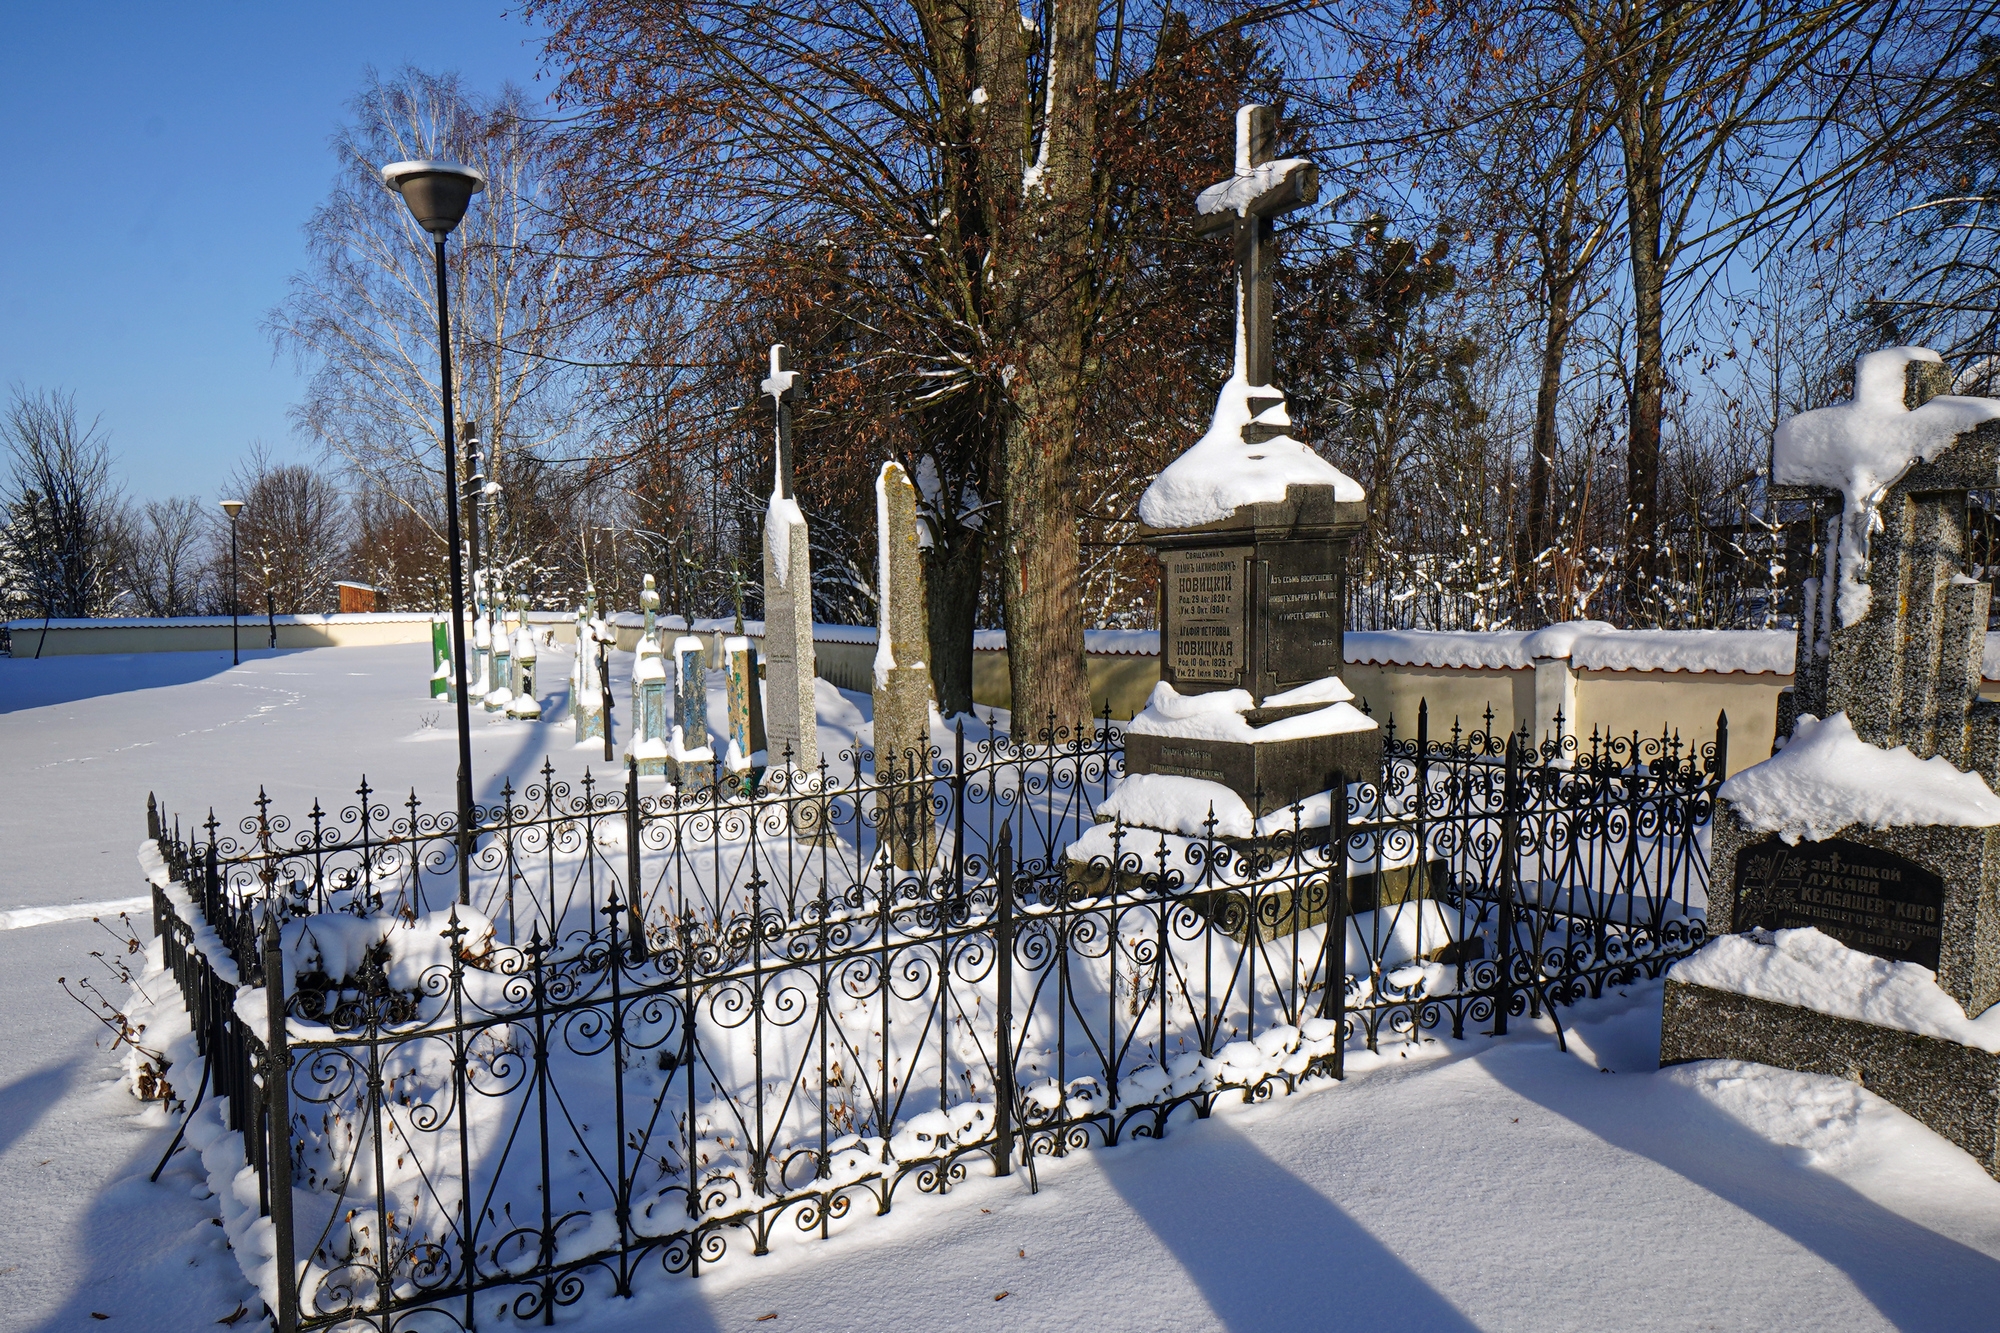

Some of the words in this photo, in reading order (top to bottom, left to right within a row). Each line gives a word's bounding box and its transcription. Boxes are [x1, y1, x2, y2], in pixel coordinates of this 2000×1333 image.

[1179, 573, 1232, 593] НОВИЦКІЙ
[1177, 641, 1233, 657] НОВИЦКАЯ
[1810, 859, 1831, 872] ЗА
[1840, 862, 1901, 882] УПОКОЙ
[1805, 872, 1880, 895] ЛУКЯНА
[1791, 902, 1863, 925] ПОГИБШЕГО
[1811, 922, 1855, 941] РАХУ
[1858, 931, 1912, 952] ТВОЕМУ
